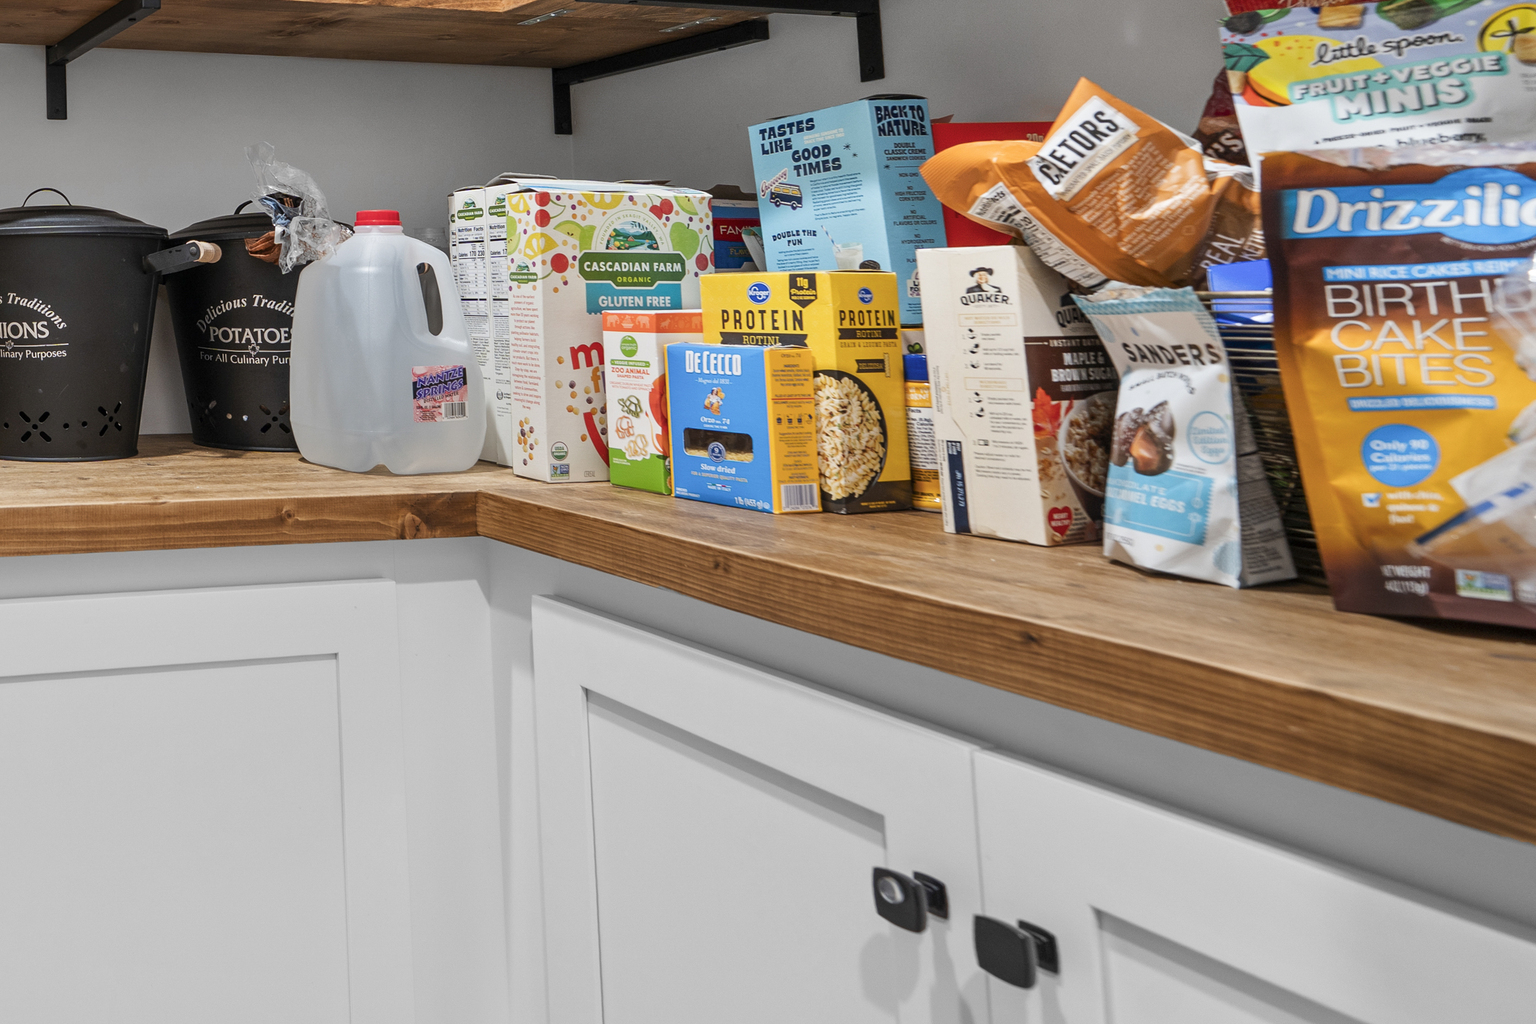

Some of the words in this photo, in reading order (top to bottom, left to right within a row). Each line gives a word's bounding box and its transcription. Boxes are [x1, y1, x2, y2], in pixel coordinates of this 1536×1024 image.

[1334, 79, 1468, 121] MINIS
[874, 106, 907, 123] BACK
[909, 105, 925, 122] TO
[759, 117, 815, 141] TASTES
[877, 119, 928, 137] NATURE
[760, 138, 792, 156] LIKE
[791, 144, 831, 163] GOOD
[793, 157, 842, 177] TIMES
[772, 230, 800, 242] DOUBLE
[801, 229, 817, 237] THE
[583, 260, 650, 273] CASCADIAN
[652, 261, 682, 273] FARM
[616, 275, 652, 283] ORGANIC
[598, 294, 643, 307] GLUTEN
[645, 295, 671, 308] FREE
[960, 293, 1010, 307] QUAKER
[7, 292, 67, 331] Traditions
[197, 297, 247, 334] Delicious
[722, 309, 803, 331] PROTEIN
[839, 309, 895, 326] PROTEIN
[856, 330, 882, 338] ROTINI
[1331, 316, 1494, 353] CAKE
[25, 348, 67, 360] Purposes
[230, 354, 269, 366] Culinary
[1122, 342, 1222, 365] SANDERS
[417, 366, 463, 388] NANTZE
[1333, 353, 1496, 388] BITES
[416, 378, 464, 401] SPRINGS
